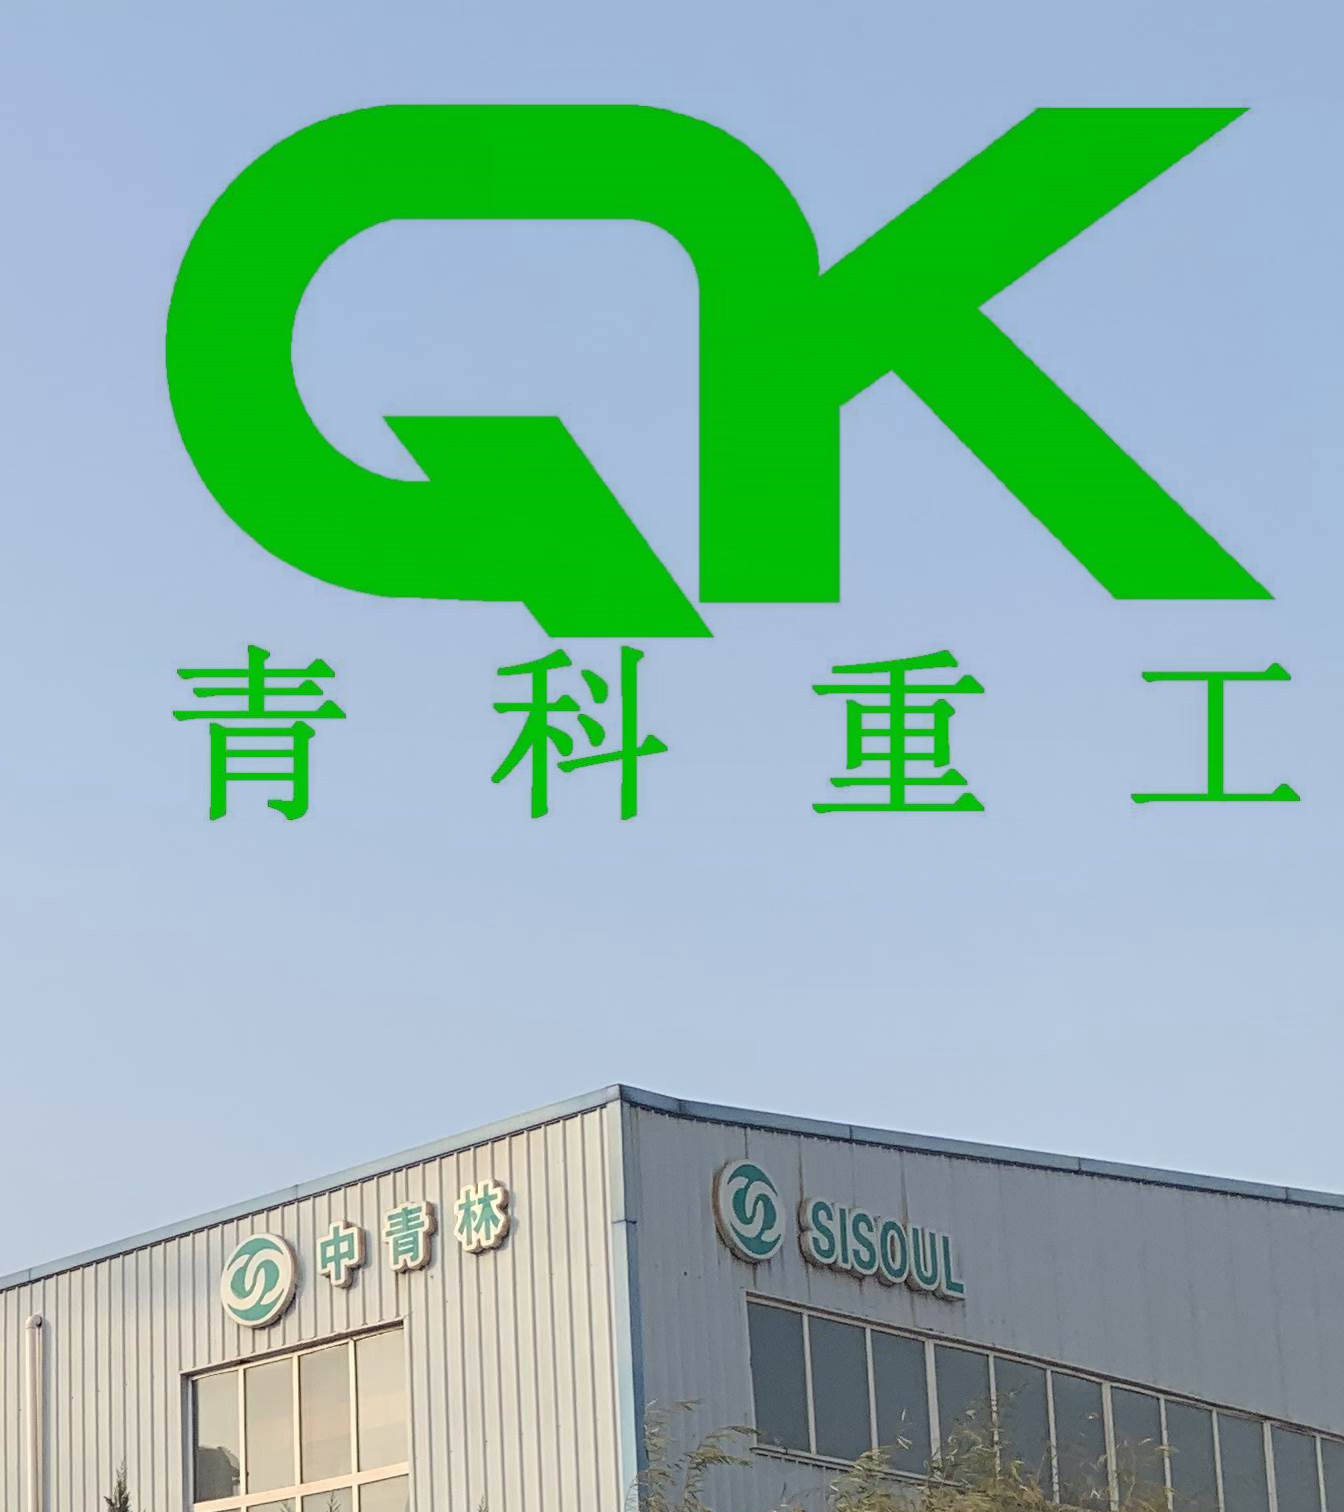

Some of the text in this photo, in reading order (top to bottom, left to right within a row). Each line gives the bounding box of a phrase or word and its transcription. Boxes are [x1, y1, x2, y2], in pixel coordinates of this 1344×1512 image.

[320, 1184, 501, 1281] 中青林
[811, 1201, 965, 1294] SISOUL
